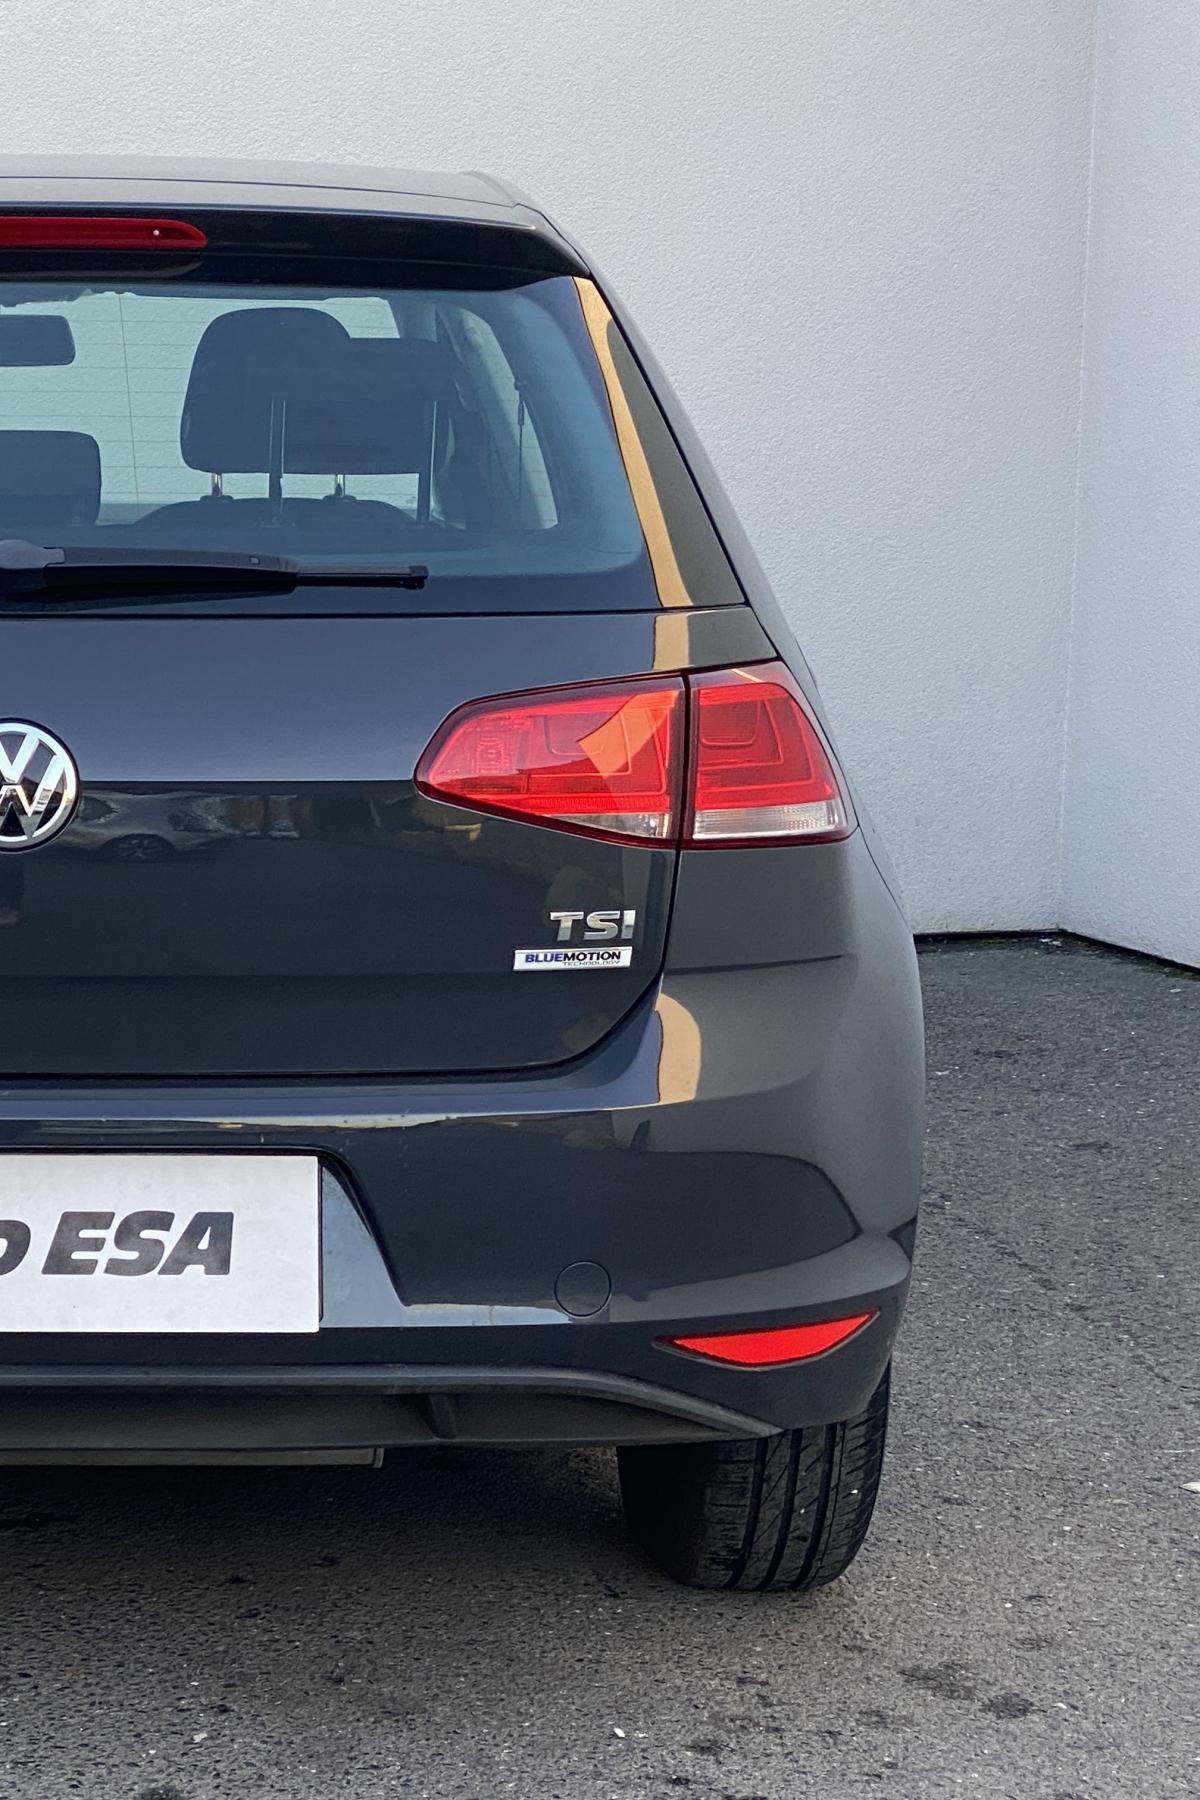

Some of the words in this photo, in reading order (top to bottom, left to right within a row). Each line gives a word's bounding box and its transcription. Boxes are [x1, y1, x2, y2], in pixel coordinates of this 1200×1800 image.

[550, 910, 636, 941] TSI
[525, 951, 621, 963] BLUEMOTION
[41, 1210, 234, 1275] ESA
